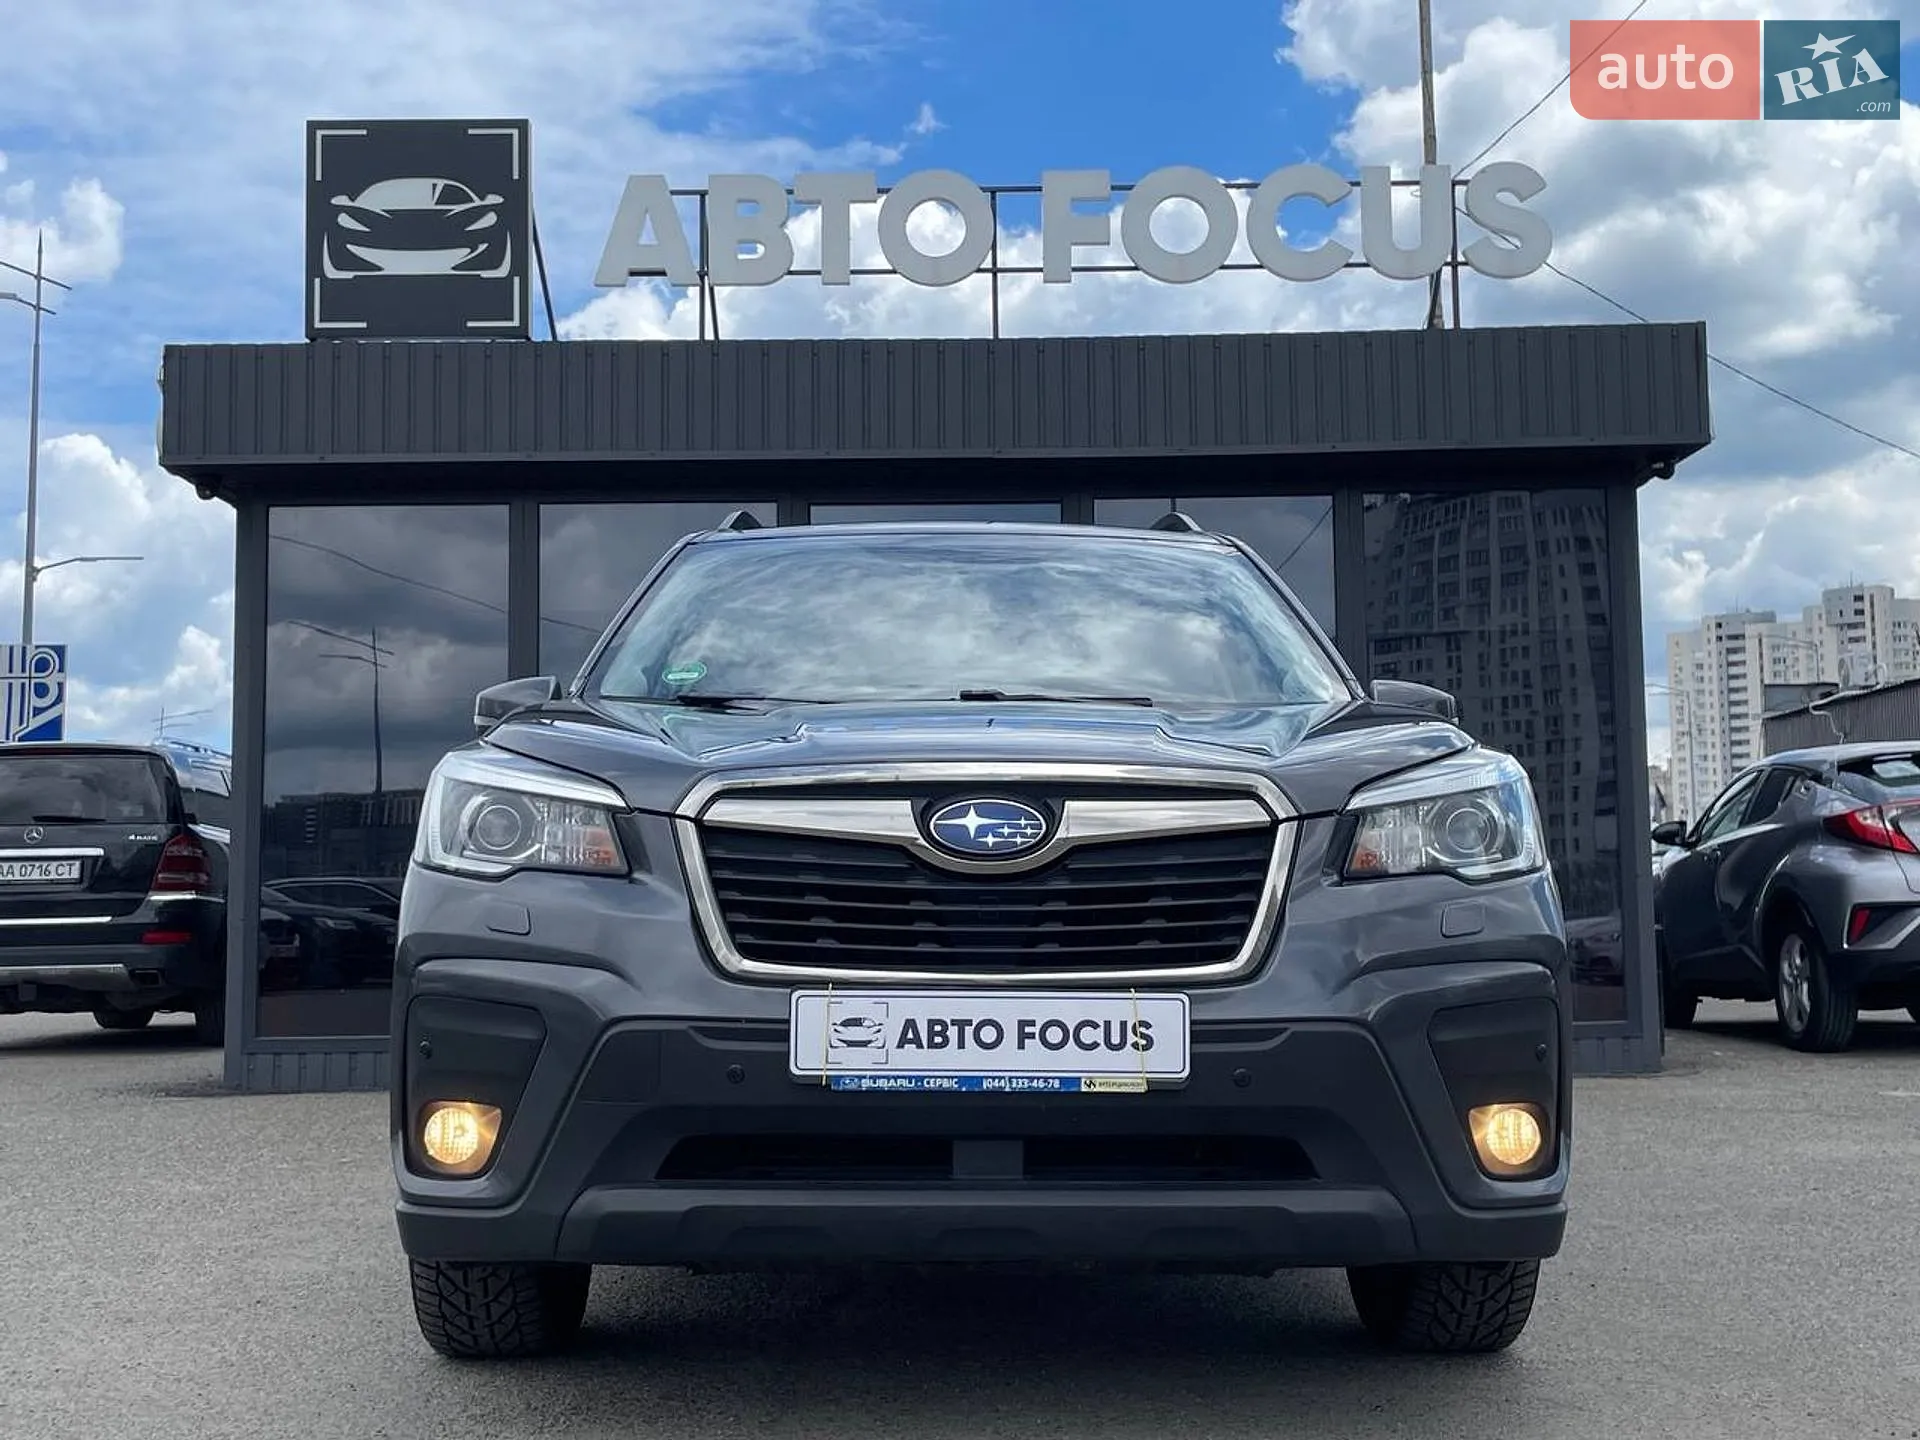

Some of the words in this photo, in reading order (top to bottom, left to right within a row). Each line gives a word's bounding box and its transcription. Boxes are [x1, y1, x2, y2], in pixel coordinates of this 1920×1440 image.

[594, 169, 995, 288] АВТО
[1042, 162, 1554, 285] FOCUS
[20, 864, 51, 877] 0716
[896, 1018, 1005, 1050] АВТО
[1016, 1019, 1155, 1051] FOCUS
[861, 1077, 915, 1088] SUBARU
[983, 1078, 1009, 1089] (044)
